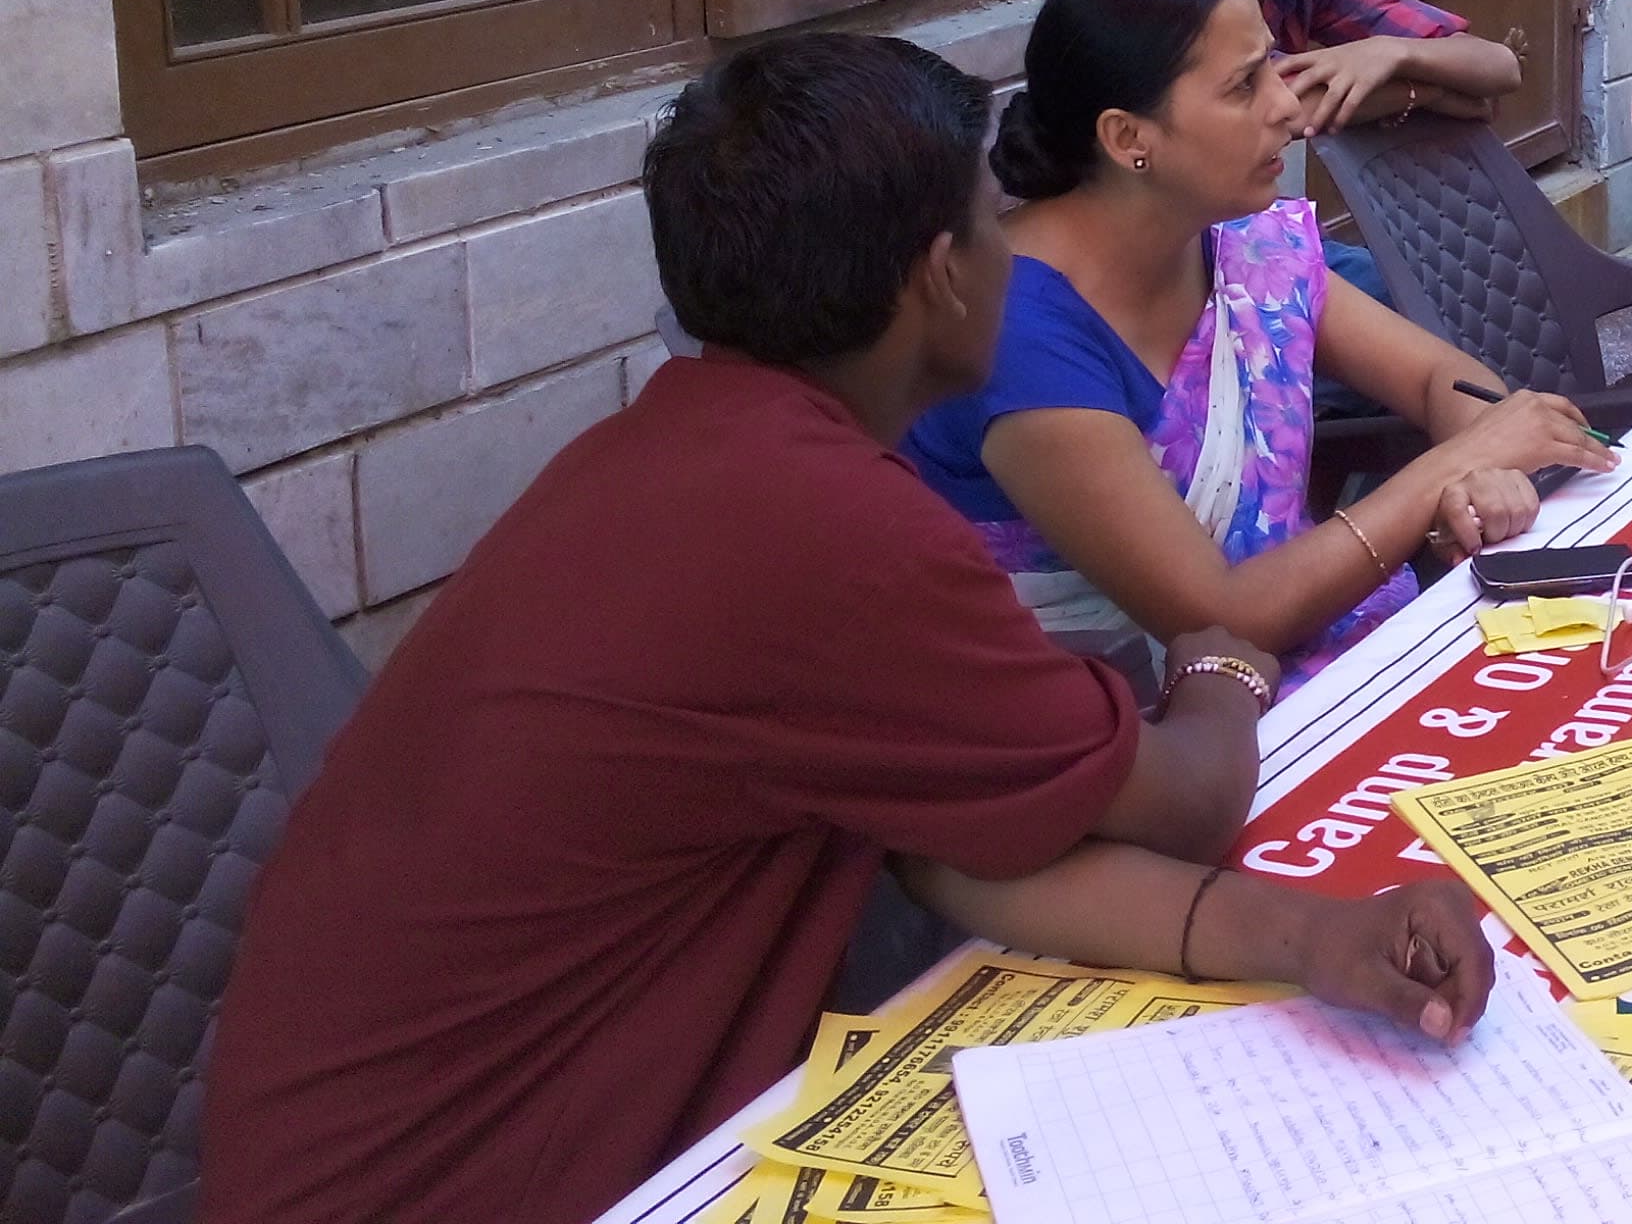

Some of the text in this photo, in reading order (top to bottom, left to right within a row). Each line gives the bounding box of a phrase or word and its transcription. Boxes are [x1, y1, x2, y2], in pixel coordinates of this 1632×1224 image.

[1242, 752, 1454, 878] Camp
[1419, 706, 1511, 738] &
[1565, 860, 1614, 879] REKHA
[1526, 884, 1604, 915] परामर्श
[962, 972, 1018, 1011] Contact
[802, 1087, 888, 1153] 9212254158
